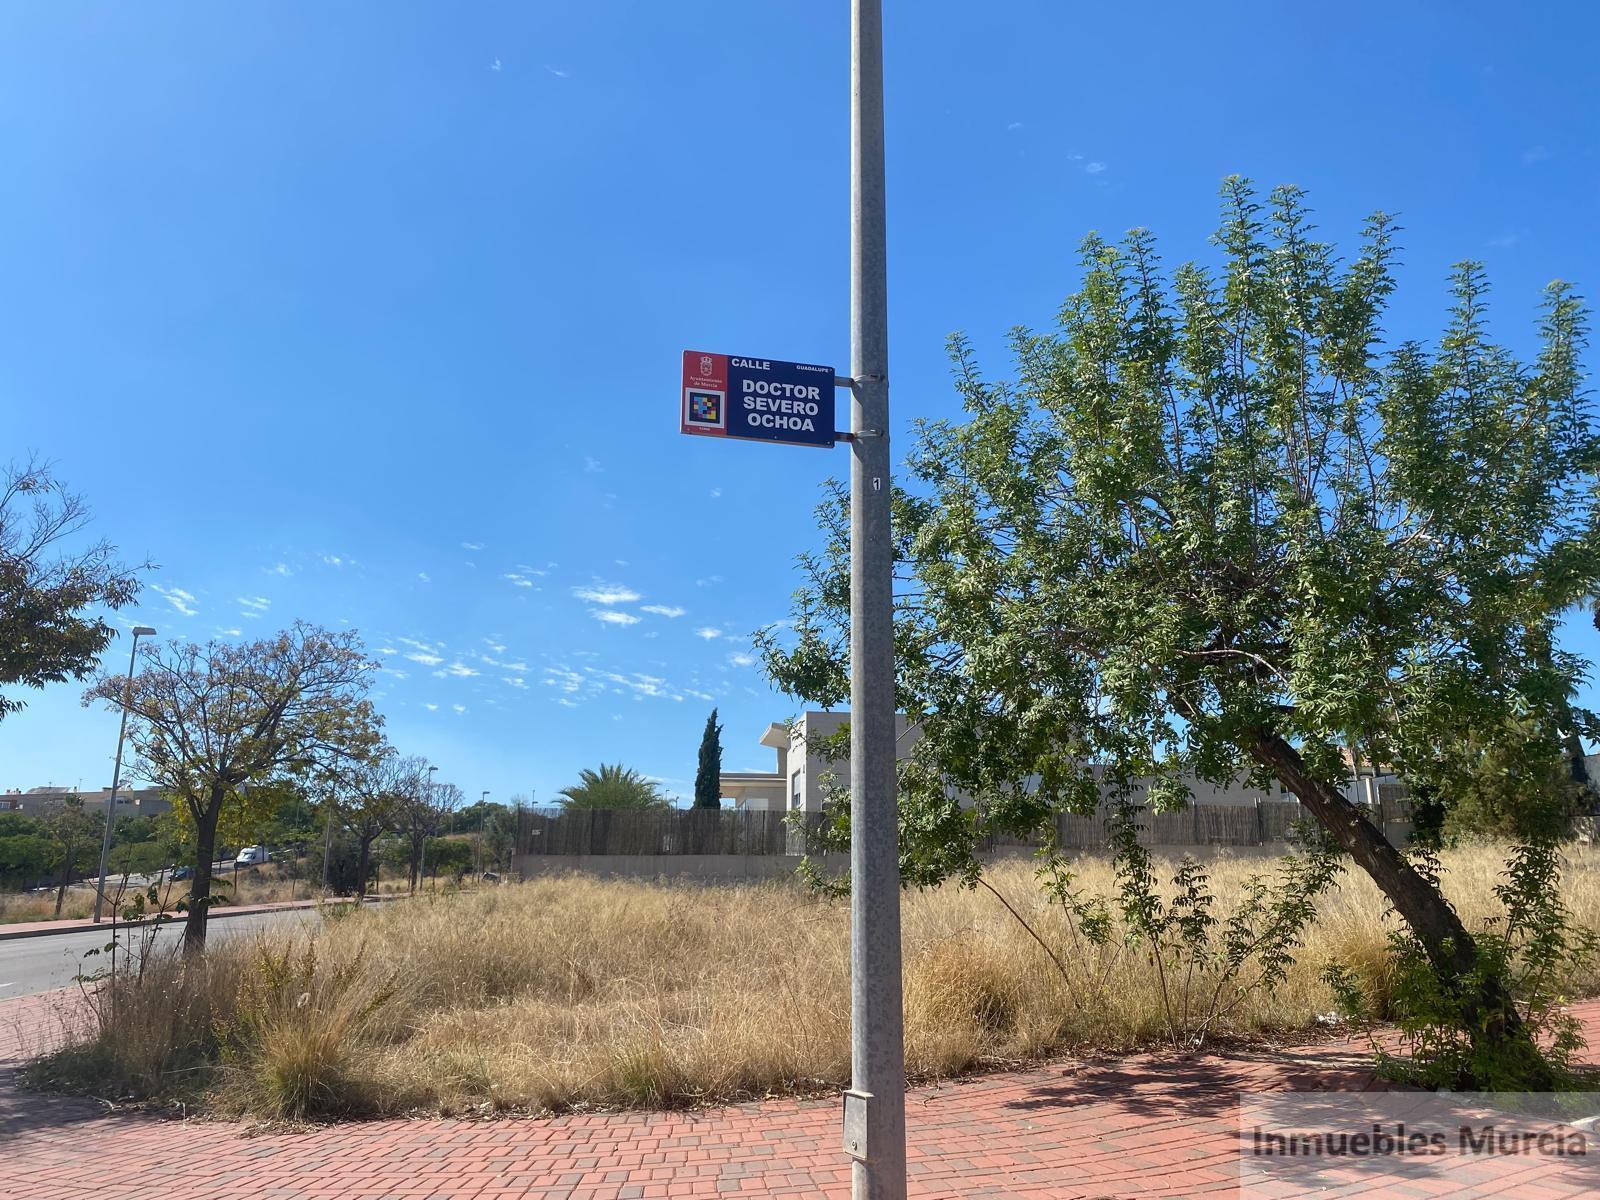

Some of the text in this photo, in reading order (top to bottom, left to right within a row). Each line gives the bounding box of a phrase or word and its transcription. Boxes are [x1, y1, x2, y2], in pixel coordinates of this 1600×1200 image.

[731, 358, 771, 370] CALLE
[796, 365, 829, 373] GUADALUPE
[742, 379, 820, 400] DOCTOR
[743, 396, 819, 416] SEVERO
[747, 413, 815, 432] OCHOA
[873, 478, 879, 490] 1
